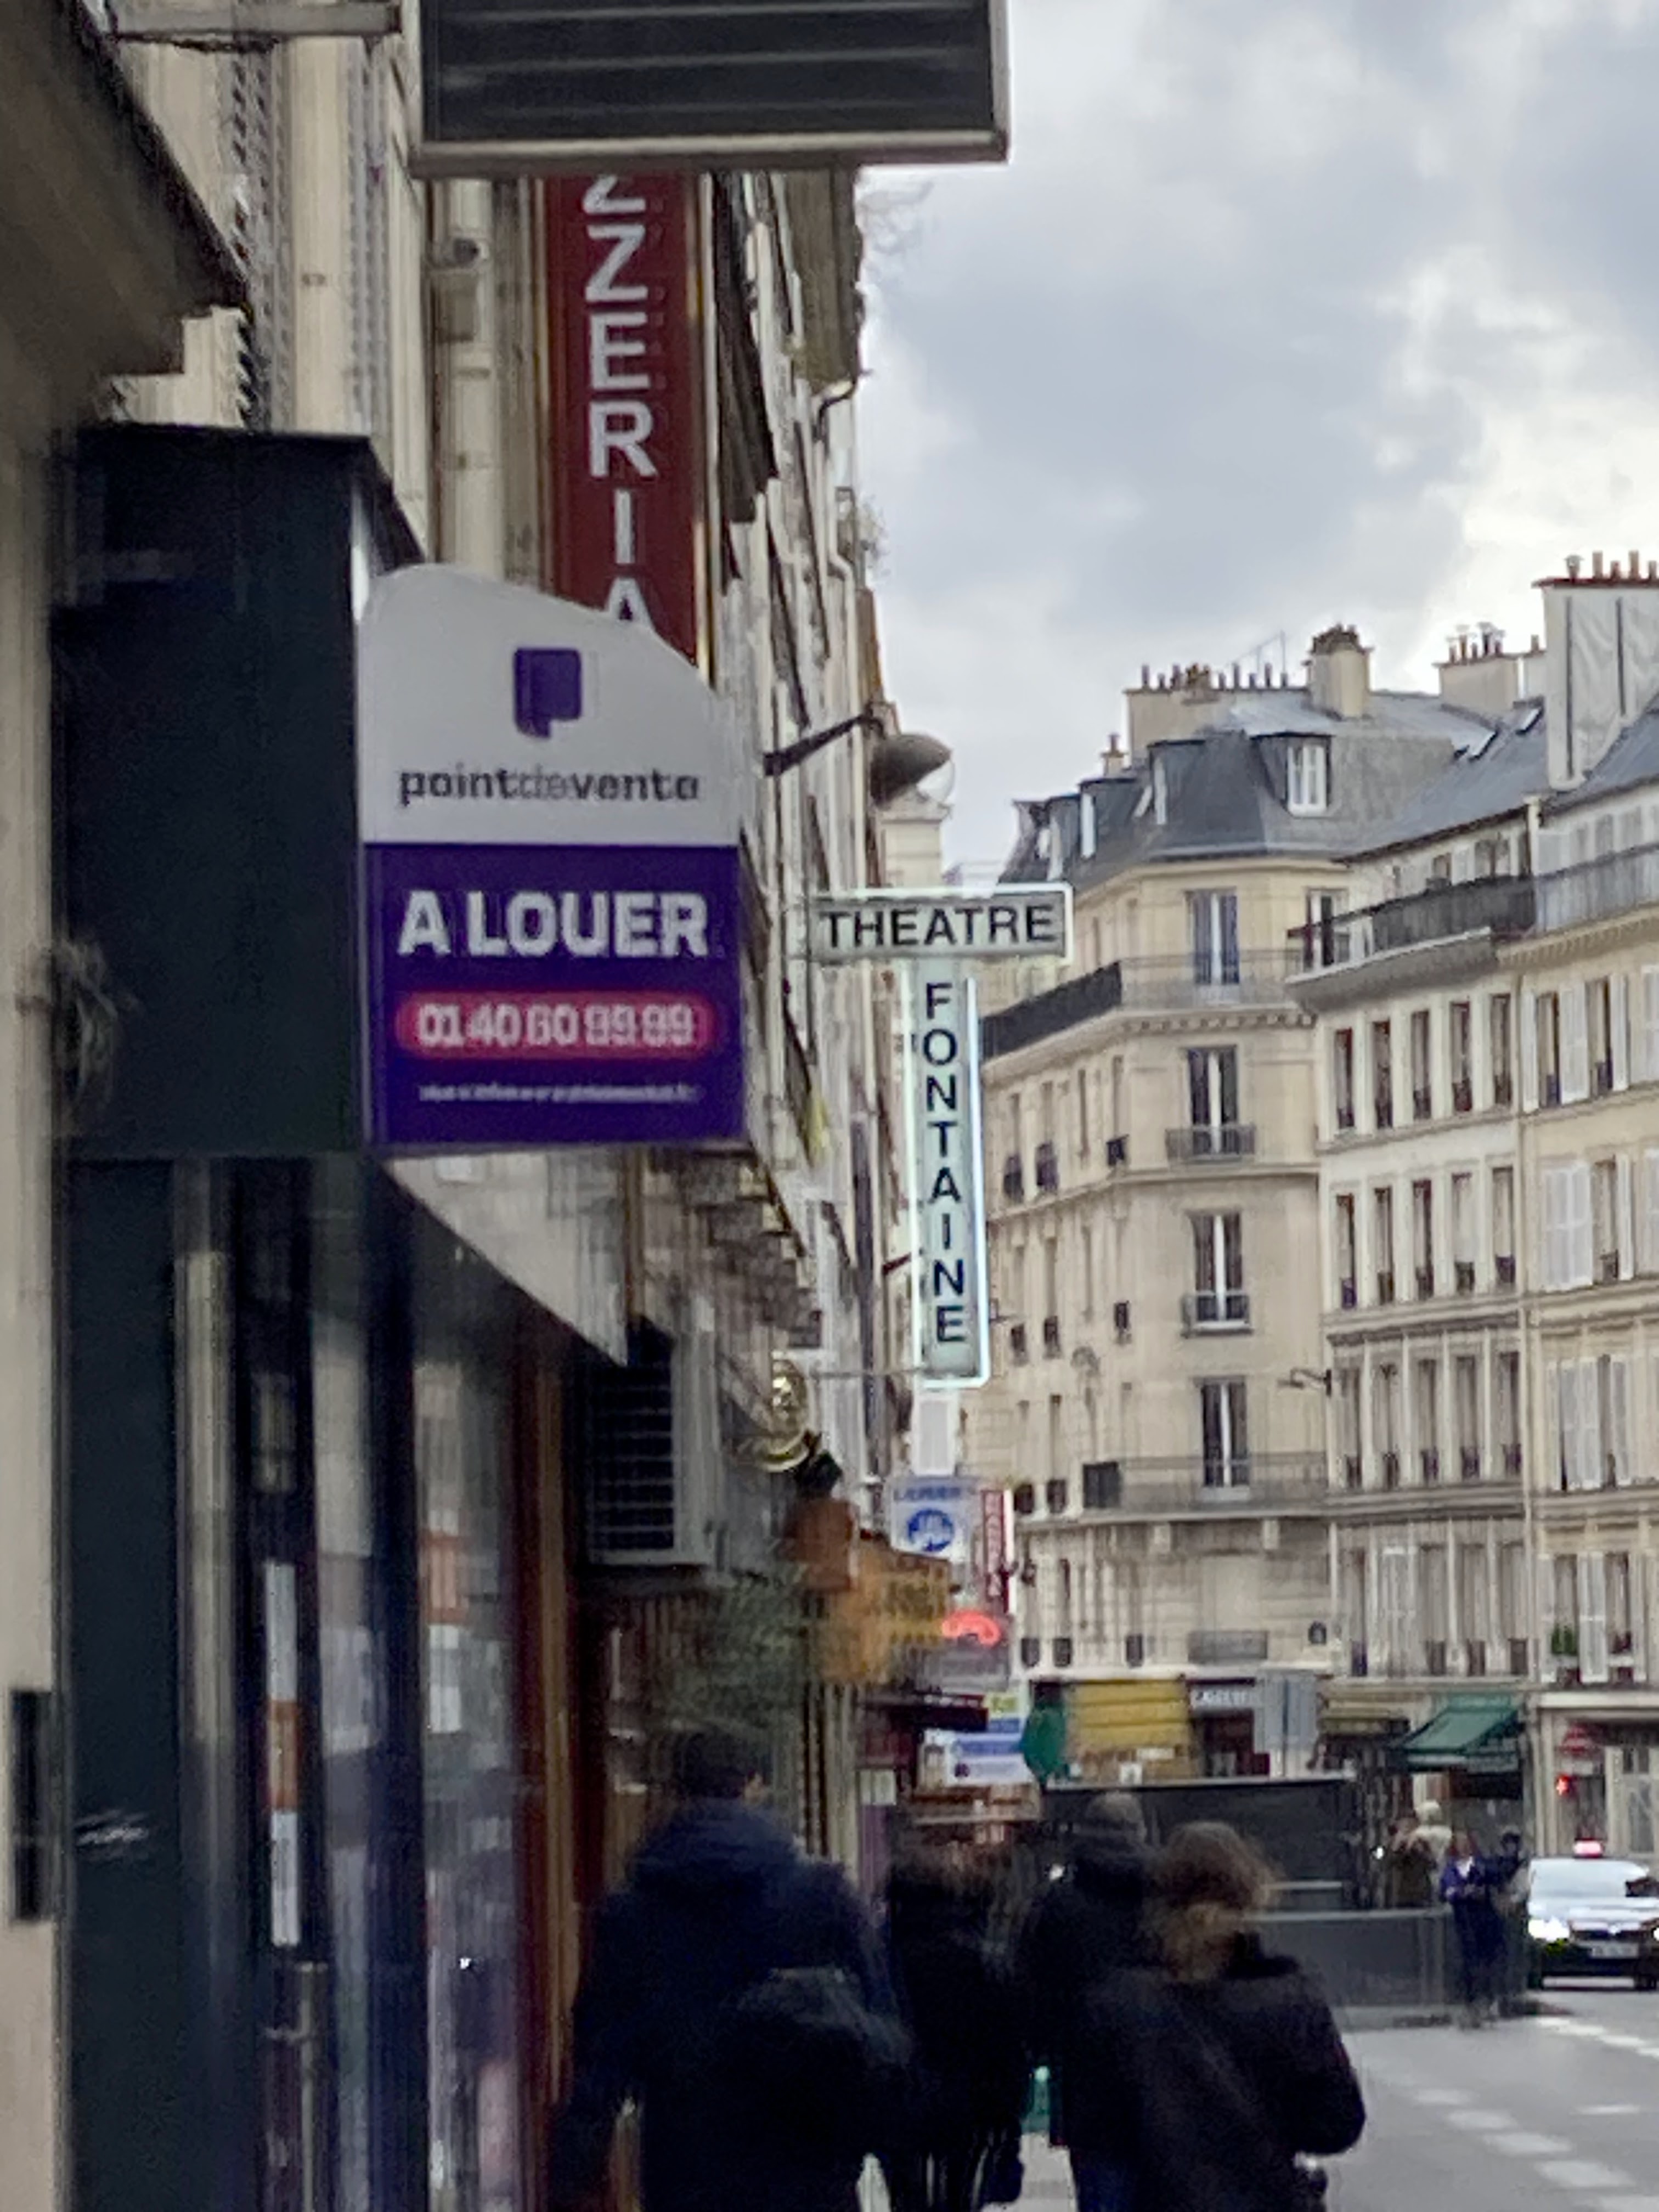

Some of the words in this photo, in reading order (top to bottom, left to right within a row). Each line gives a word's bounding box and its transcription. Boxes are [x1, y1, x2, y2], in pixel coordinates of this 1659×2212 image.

[397, 890, 452, 957] A
[467, 890, 708, 957] LOUER
[820, 904, 1058, 948] THEATRE
[922, 981, 966, 1344] FONTAINE
